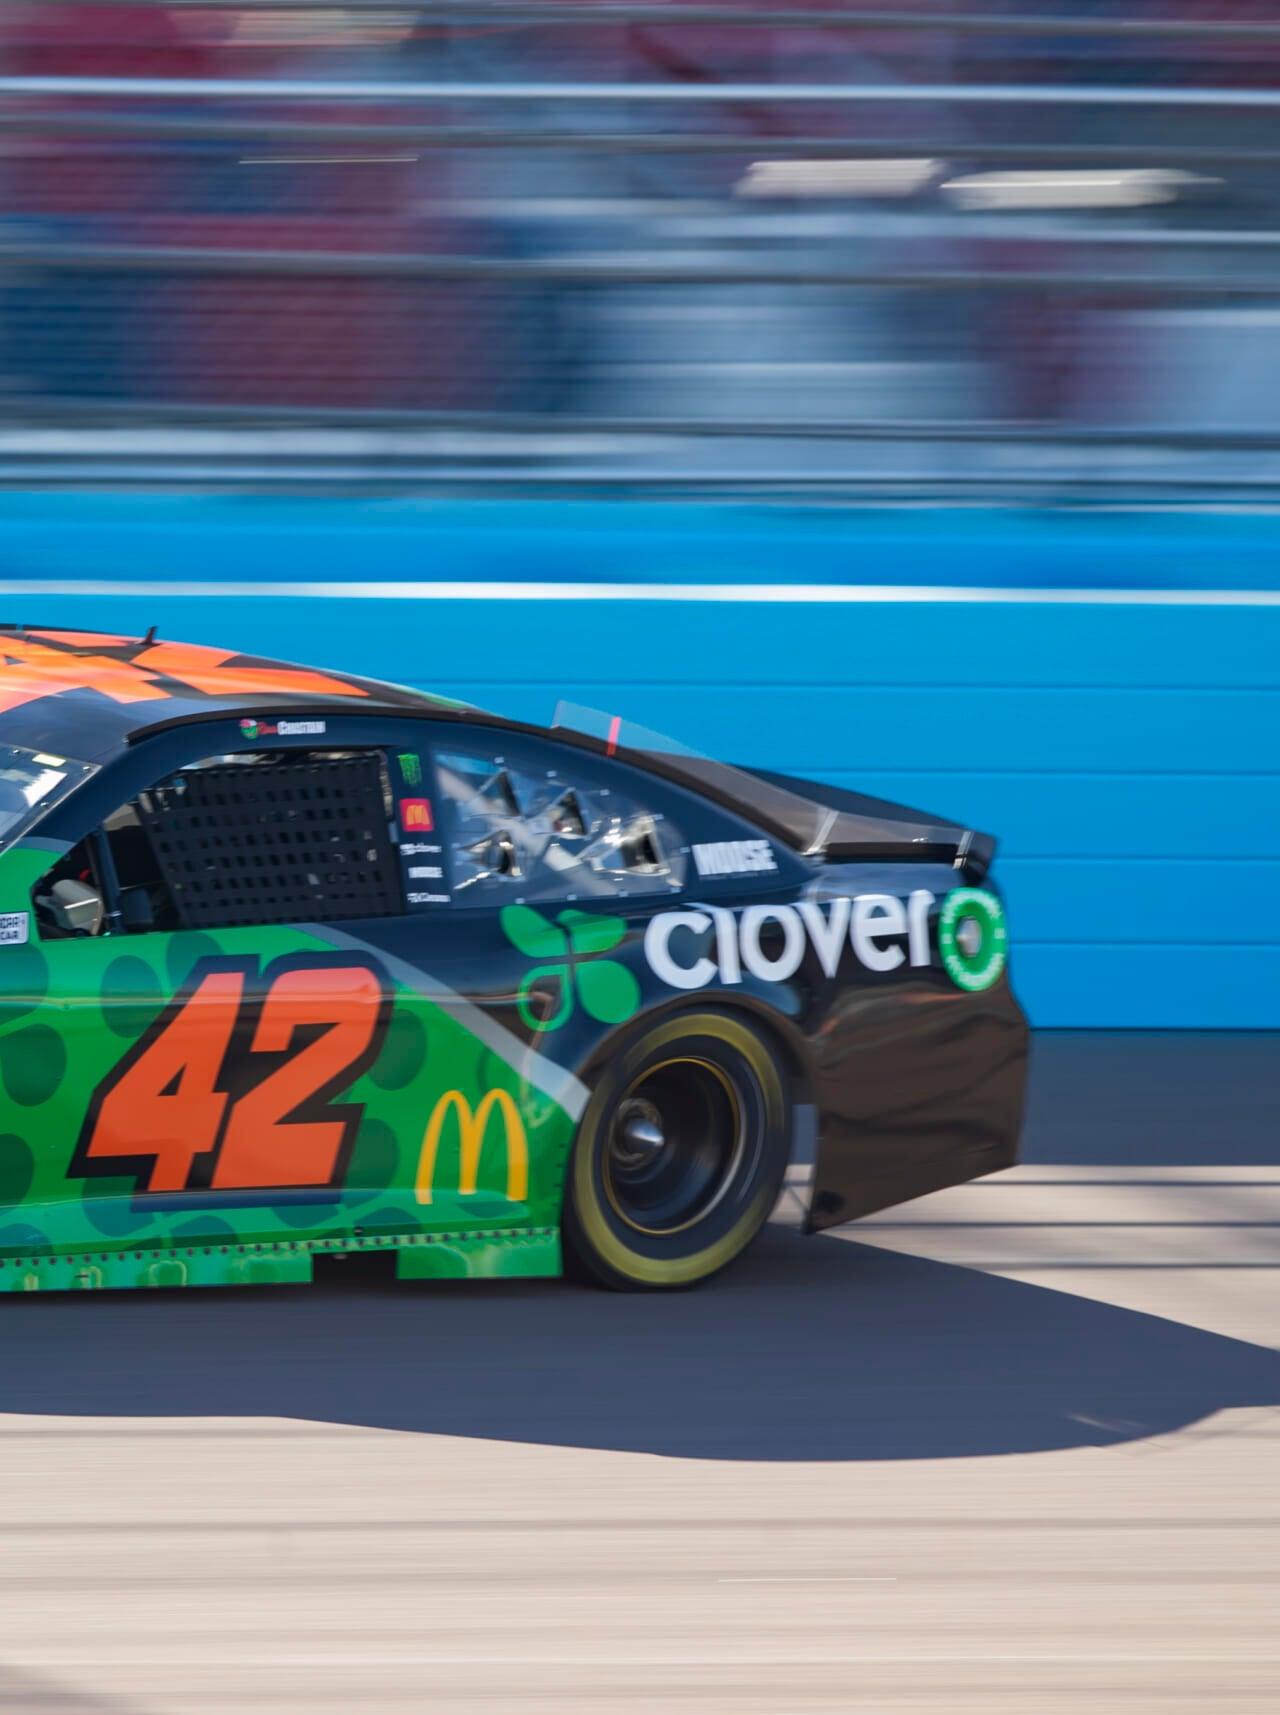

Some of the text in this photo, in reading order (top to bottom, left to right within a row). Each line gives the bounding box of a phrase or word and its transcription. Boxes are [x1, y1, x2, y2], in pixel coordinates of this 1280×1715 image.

[0, 931, 19, 941] CAR
[643, 889, 936, 989] clover
[85, 966, 384, 1192] 42
